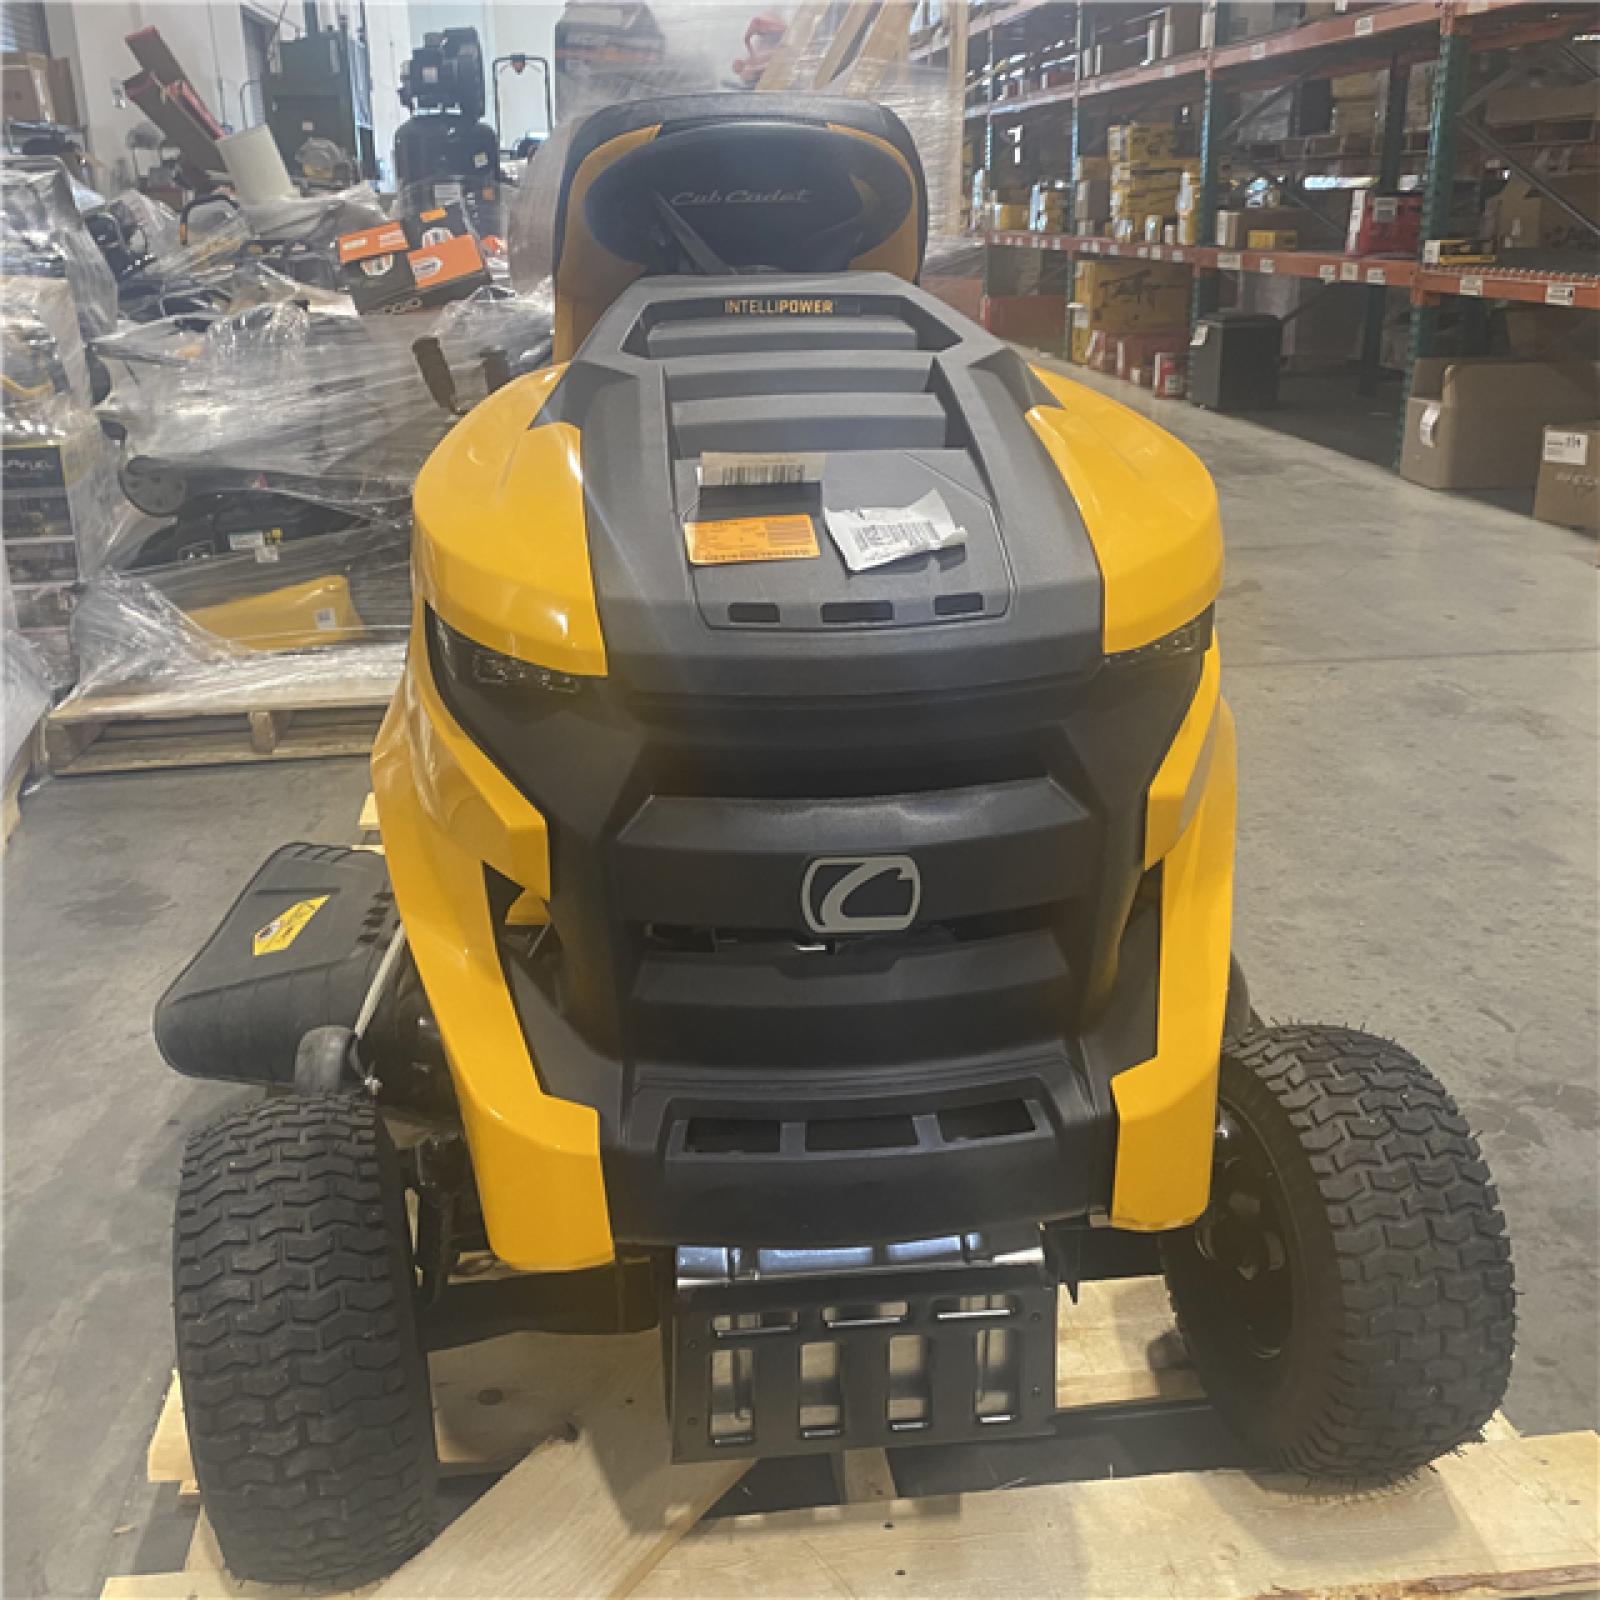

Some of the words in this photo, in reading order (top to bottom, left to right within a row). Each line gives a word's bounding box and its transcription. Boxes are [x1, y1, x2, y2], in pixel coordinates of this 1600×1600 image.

[671, 189, 721, 206] Cub
[724, 188, 813, 204] Cadet
[724, 299, 833, 314] INTELLIPOWER
